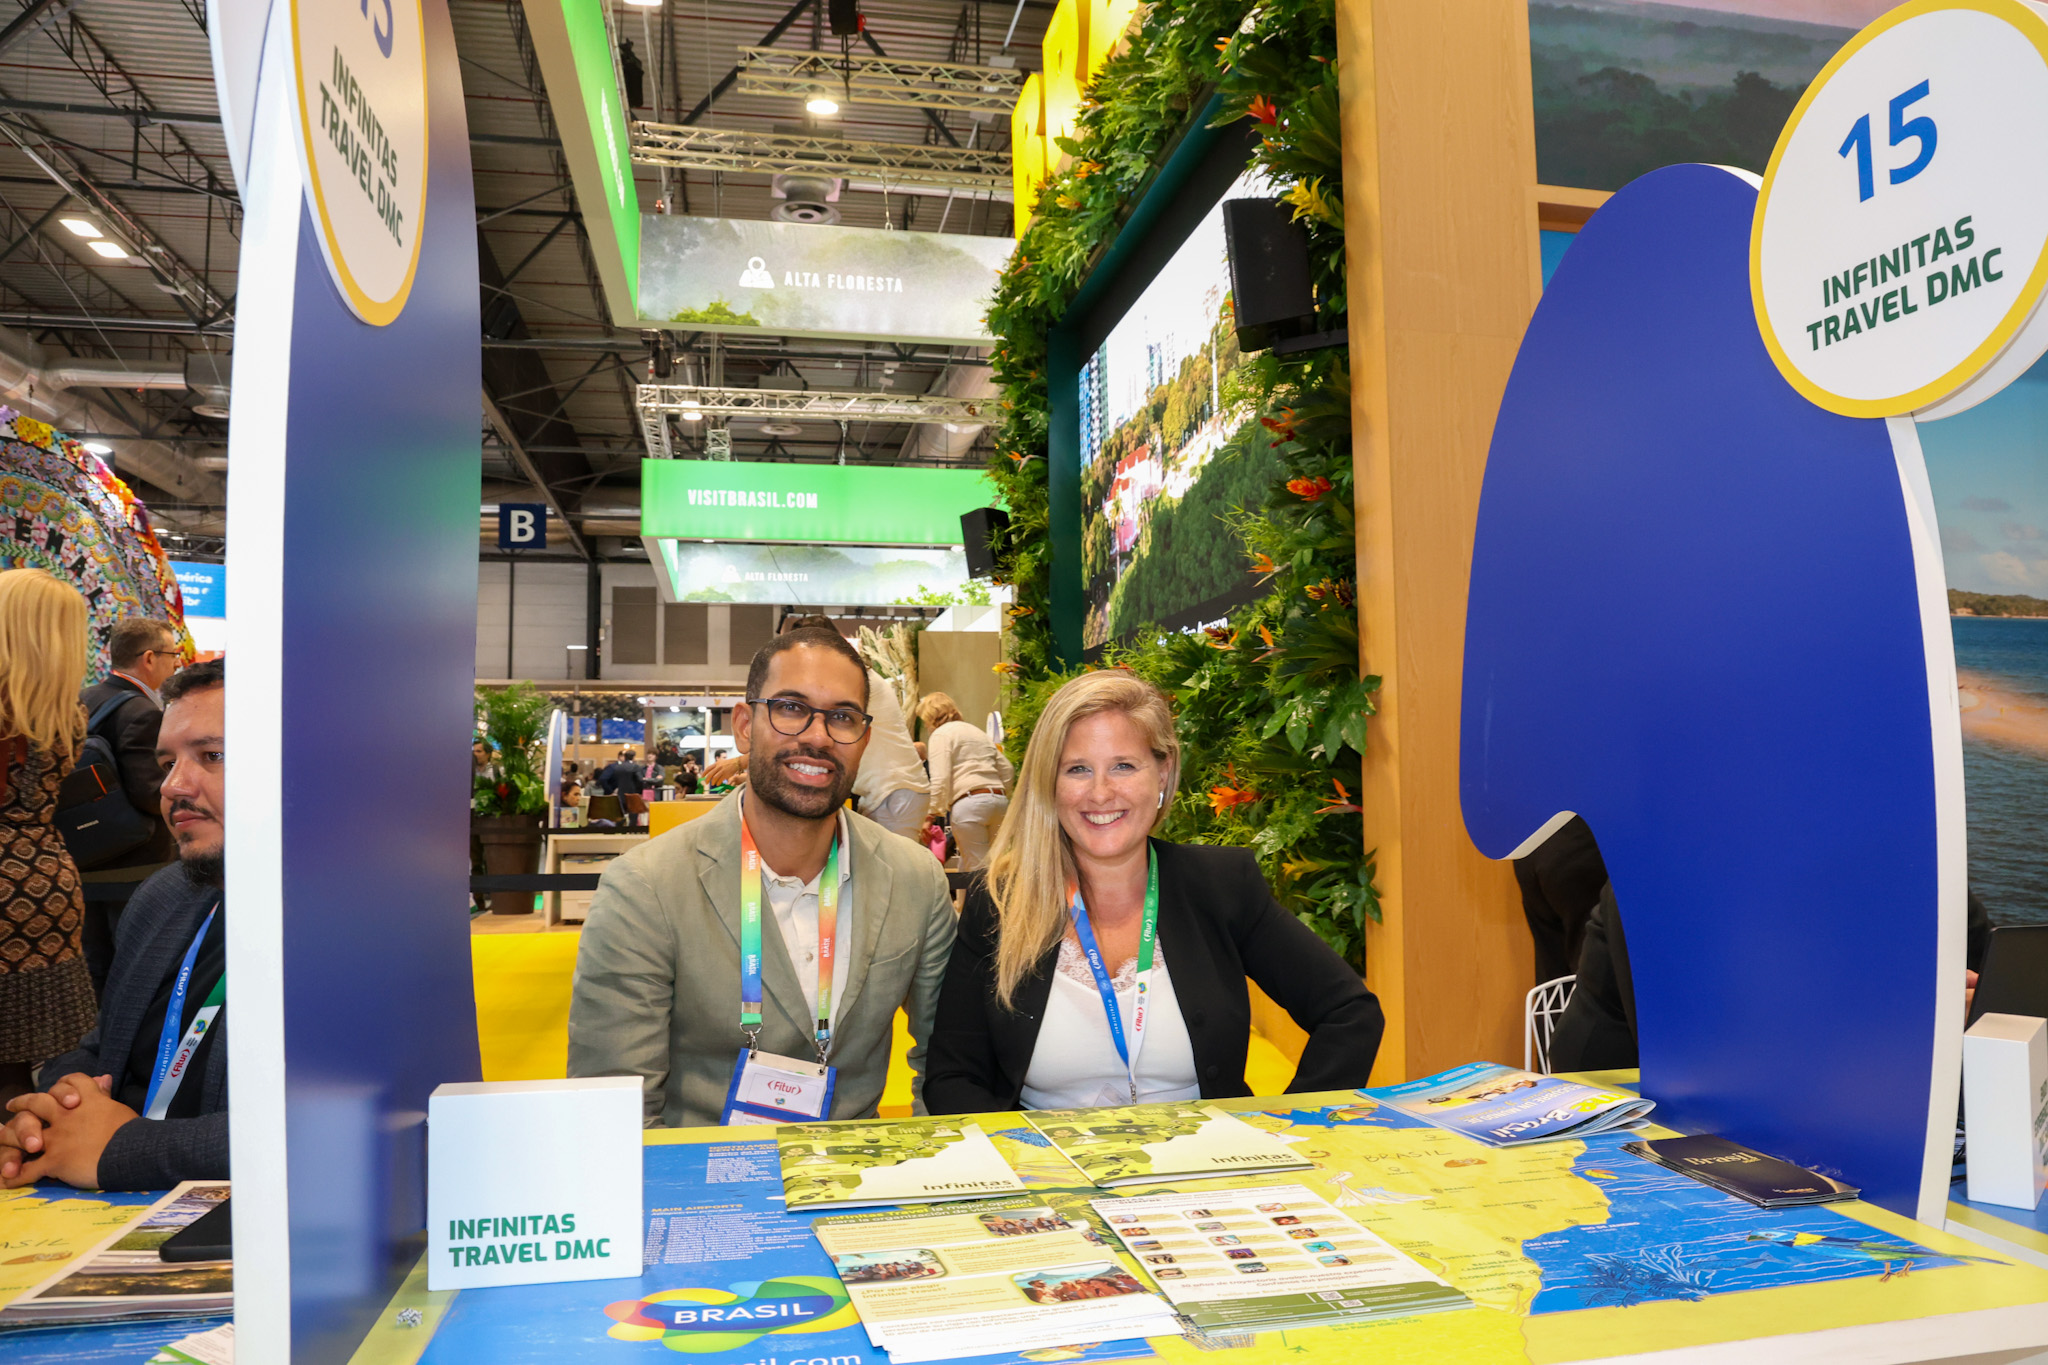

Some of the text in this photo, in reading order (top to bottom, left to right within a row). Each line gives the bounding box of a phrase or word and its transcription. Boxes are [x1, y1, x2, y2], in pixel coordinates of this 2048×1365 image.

[332, 45, 398, 188] INFINITAS
[1838, 78, 1938, 203] 15
[319, 80, 404, 248] TRAVEL DMC
[1823, 215, 1975, 308] INFINITAS
[784, 271, 903, 293] ALTA FLORESTA
[1806, 247, 2004, 351] TRAVEL DMC
[687, 489, 818, 509] VISITBRASIL.COM
[510, 509, 535, 543] B
[744, 571, 809, 582] ALTA FLORESTA
[1211, 1153, 1292, 1164] Infinitas
[923, 1180, 1012, 1191] Infinitas
[685, 1203, 744, 1211] AIRPORTS
[826, 1212, 883, 1221] Infinitas
[886, 1208, 929, 1216] Travel
[946, 1202, 984, 1211] mejor
[983, 1198, 1032, 1208] opción
[872, 1210, 951, 1222] organización
[970, 1204, 1005, 1213] viajes
[1006, 1202, 1034, 1210] MICE
[449, 1213, 575, 1241] INFINITAS
[448, 1238, 611, 1268] TRAVEL DMC
[674, 1302, 815, 1326] BRASIL
